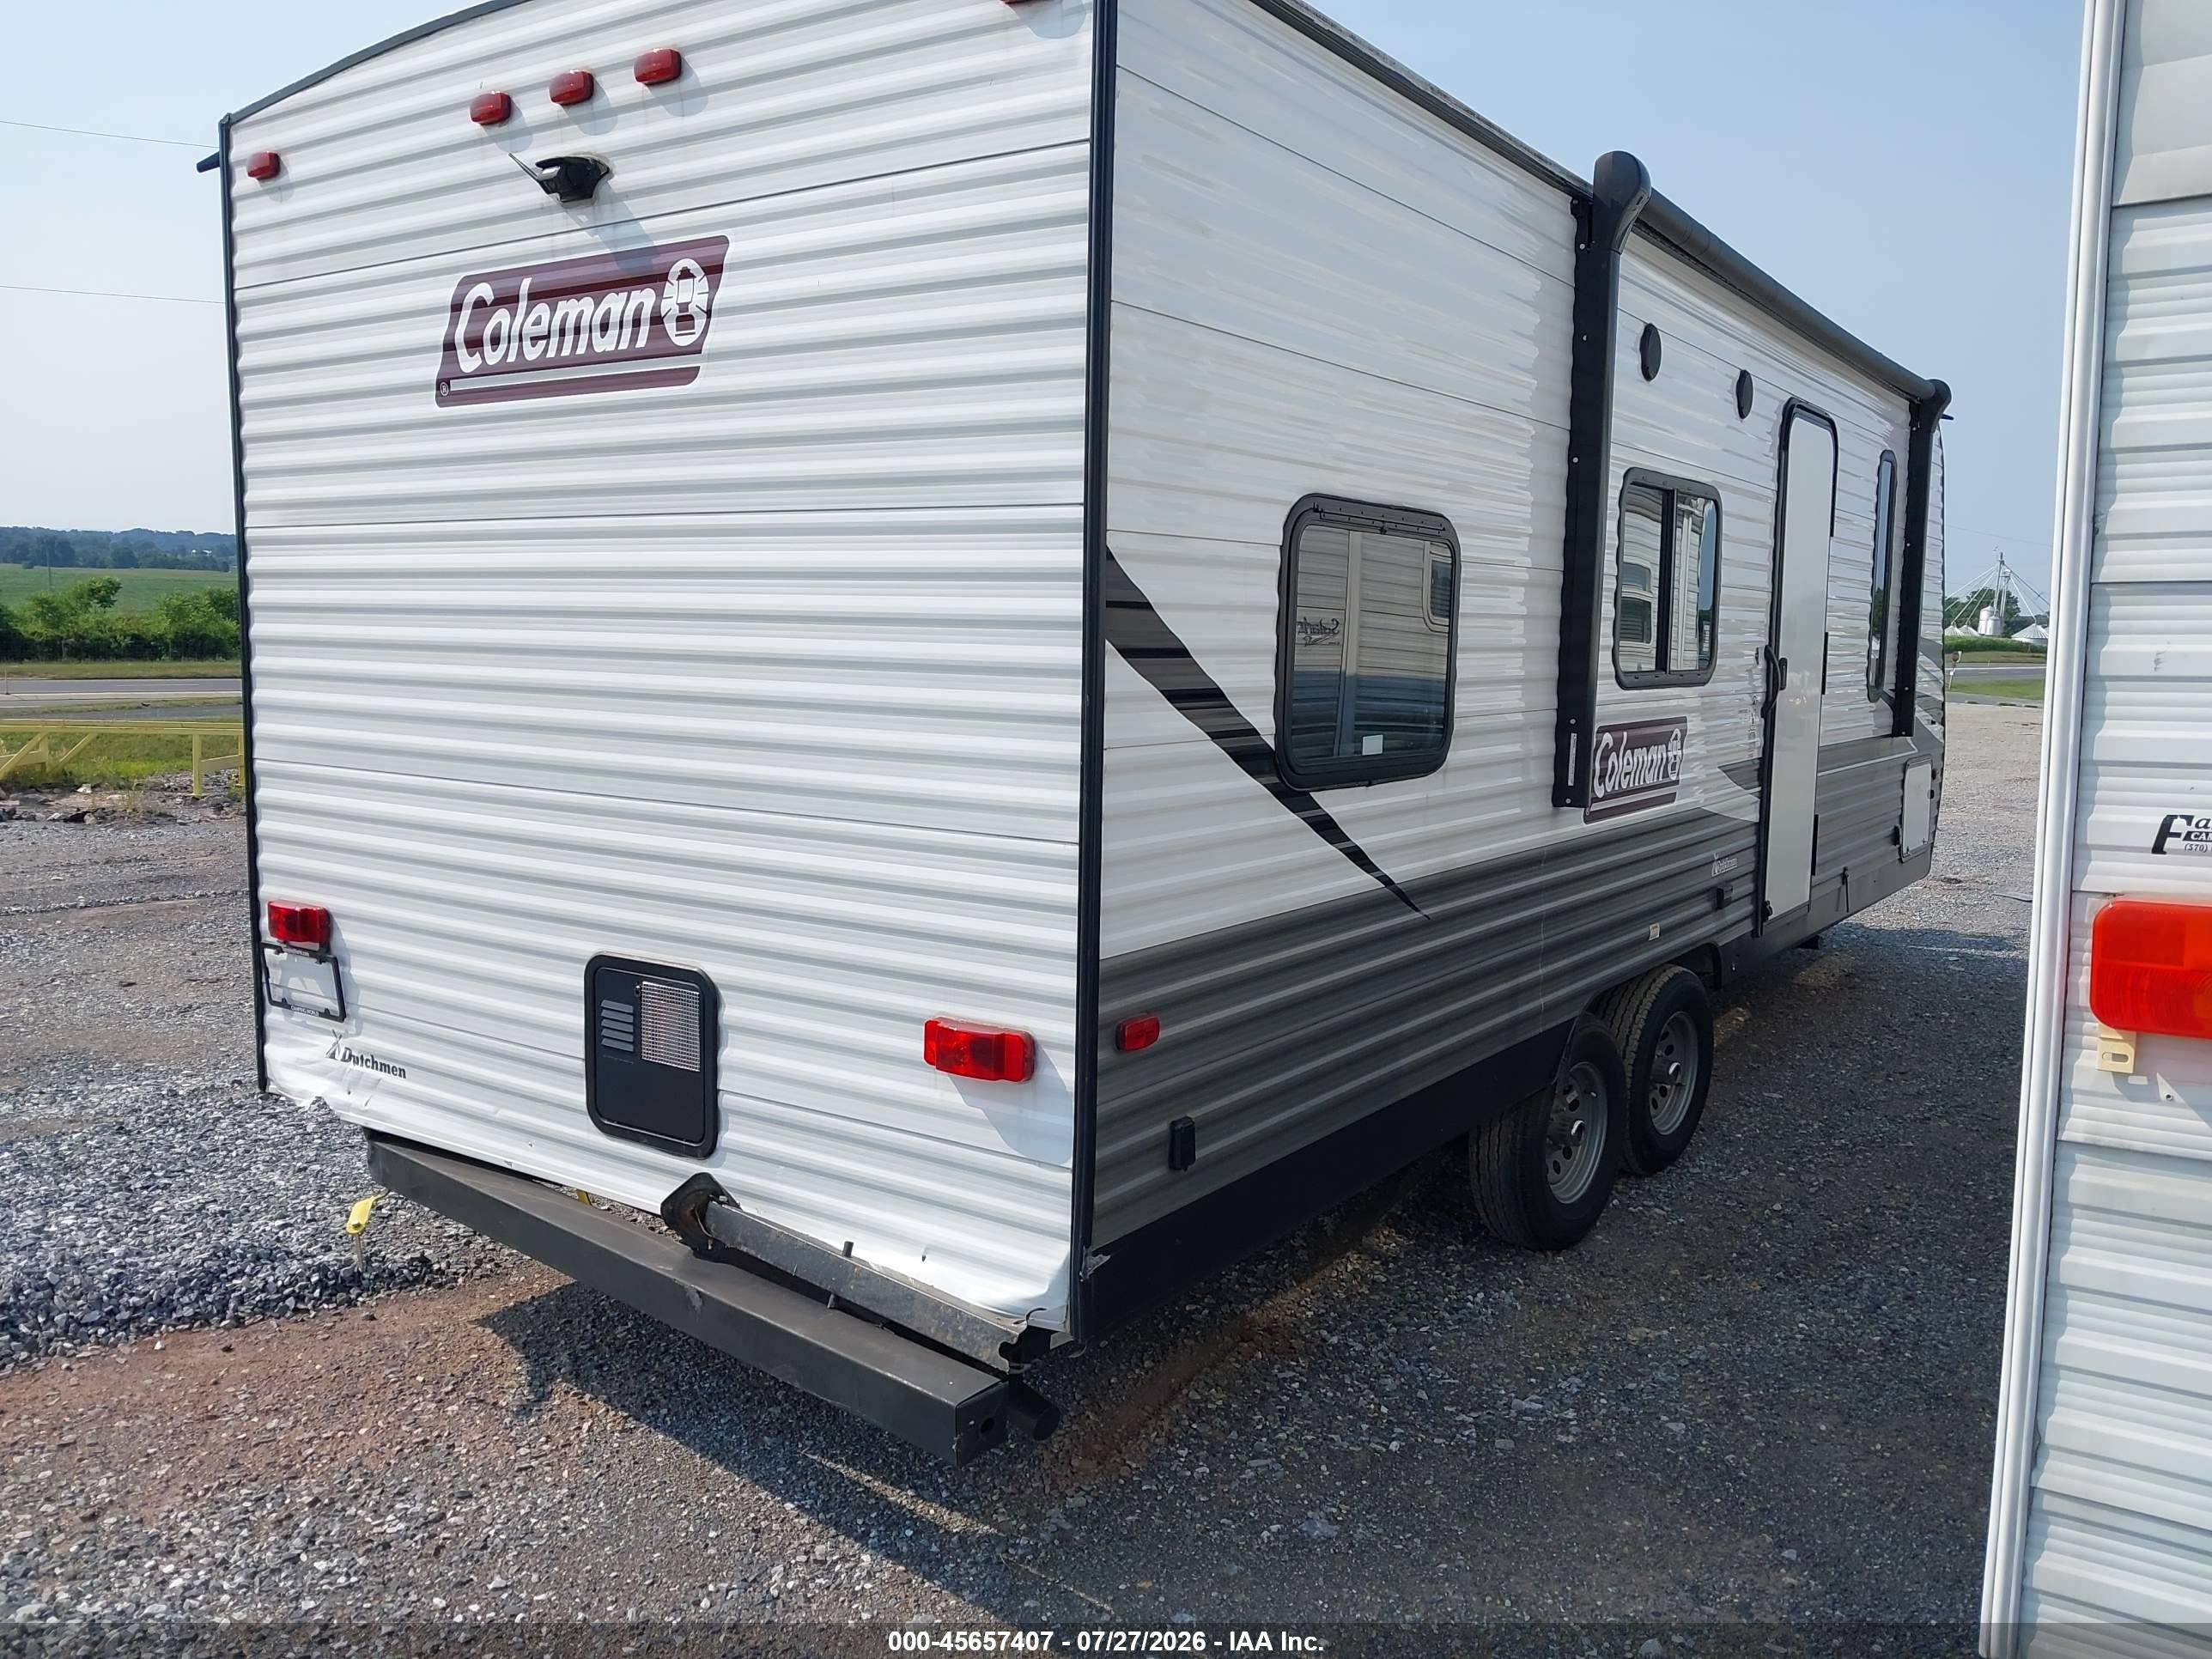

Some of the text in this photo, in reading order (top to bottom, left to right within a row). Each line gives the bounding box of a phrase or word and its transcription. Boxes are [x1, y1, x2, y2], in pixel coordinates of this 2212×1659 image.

[453, 276, 657, 374] Coleman
[1593, 731, 1667, 799] Coleman
[2150, 814, 2212, 855] Fa
[2184, 842, 2209, 854] (570)
[341, 1047, 407, 1079] Dutchmen
